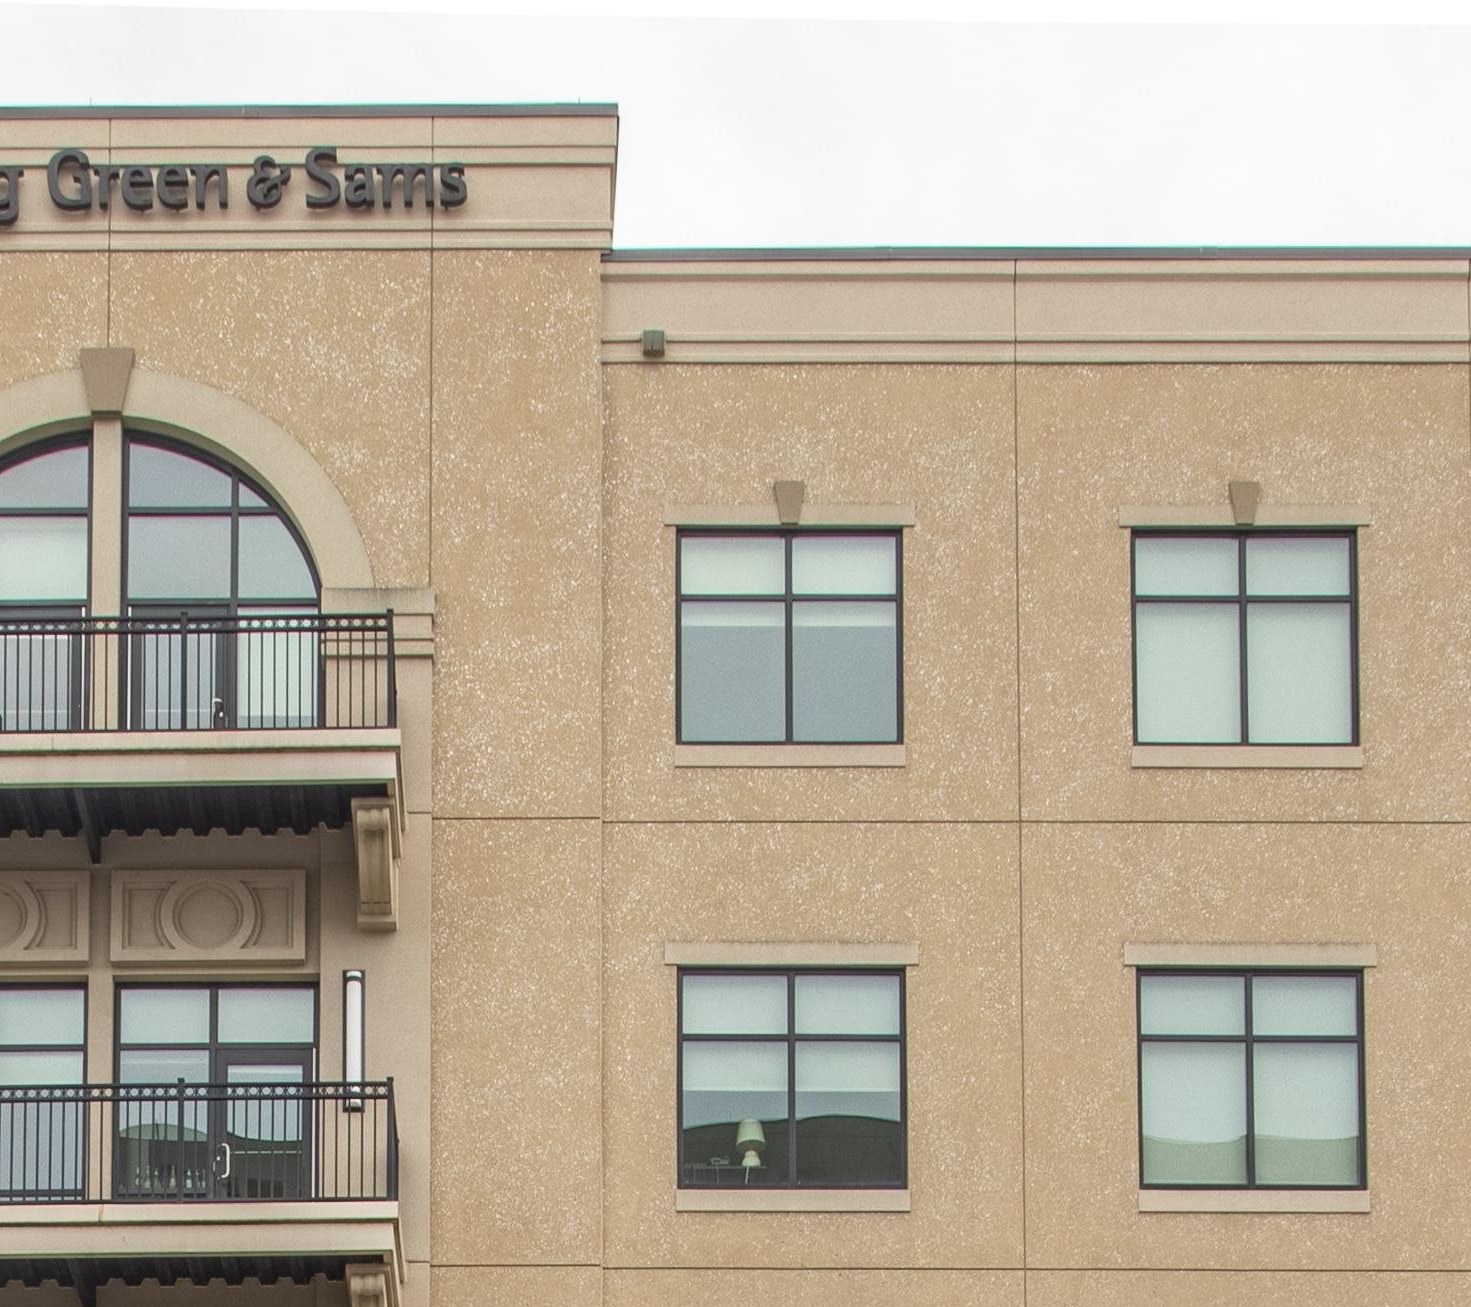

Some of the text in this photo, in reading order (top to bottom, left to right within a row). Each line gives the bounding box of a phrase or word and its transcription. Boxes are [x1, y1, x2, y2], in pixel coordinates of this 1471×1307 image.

[47, 148, 229, 213] Green
[247, 154, 292, 210] &
[304, 147, 468, 210] Sams
